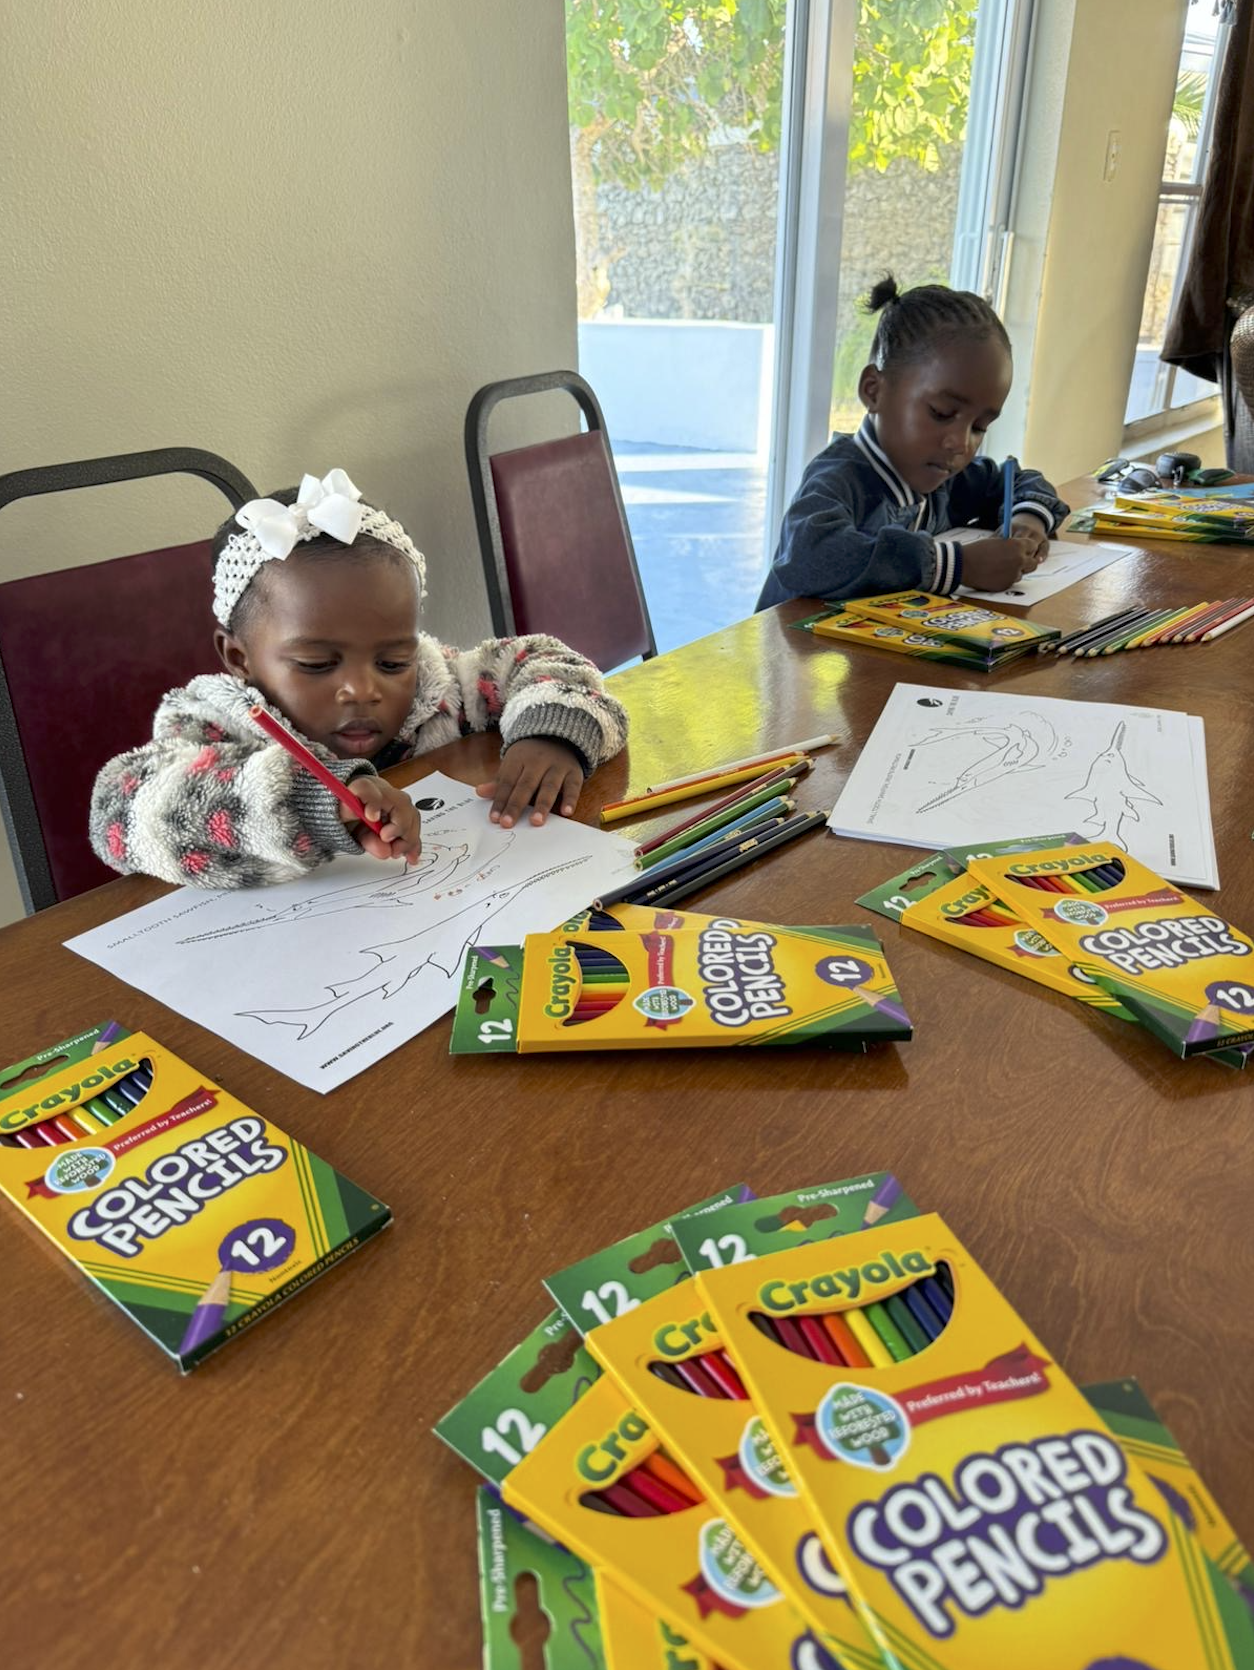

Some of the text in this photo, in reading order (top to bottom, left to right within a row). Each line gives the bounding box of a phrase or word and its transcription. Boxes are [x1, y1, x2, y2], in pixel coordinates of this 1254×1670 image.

[1009, 853, 1107, 876] Crayola
[883, 895, 917, 912] 12
[941, 883, 991, 916] Cray
[1083, 917, 1225, 954] COLORED
[1108, 933, 1249, 975] PENCILS
[545, 946, 577, 1018] Crayola
[702, 929, 749, 1026] COLORED
[735, 932, 790, 1019] PENCILS
[827, 960, 862, 981] 12
[1216, 987, 1254, 1009] 12
[36, 1028, 100, 1062] Pre-Sharpened
[477, 1018, 513, 1044] 12
[0, 1058, 137, 1130] Crayola
[113, 1098, 213, 1152] Preferred by Teachers!
[72, 1118, 263, 1238] COLORED
[103, 1140, 284, 1256] PENCILS
[796, 1178, 875, 1203] Pre-Sharpened
[231, 1227, 287, 1266] 12
[281, 1260, 326, 1296] COLORED
[324, 1236, 360, 1264] PENCILS
[699, 1234, 758, 1269] 12
[582, 1280, 641, 1325] 12
[758, 1250, 932, 1312] Crayola
[906, 1371, 1041, 1412] Preferred by Teachers!
[482, 1407, 546, 1465] 12
[853, 1433, 1122, 1565] COLORED
[487, 1508, 508, 1613] Pre-Sharpened
[894, 1487, 1164, 1634] PENCILS
